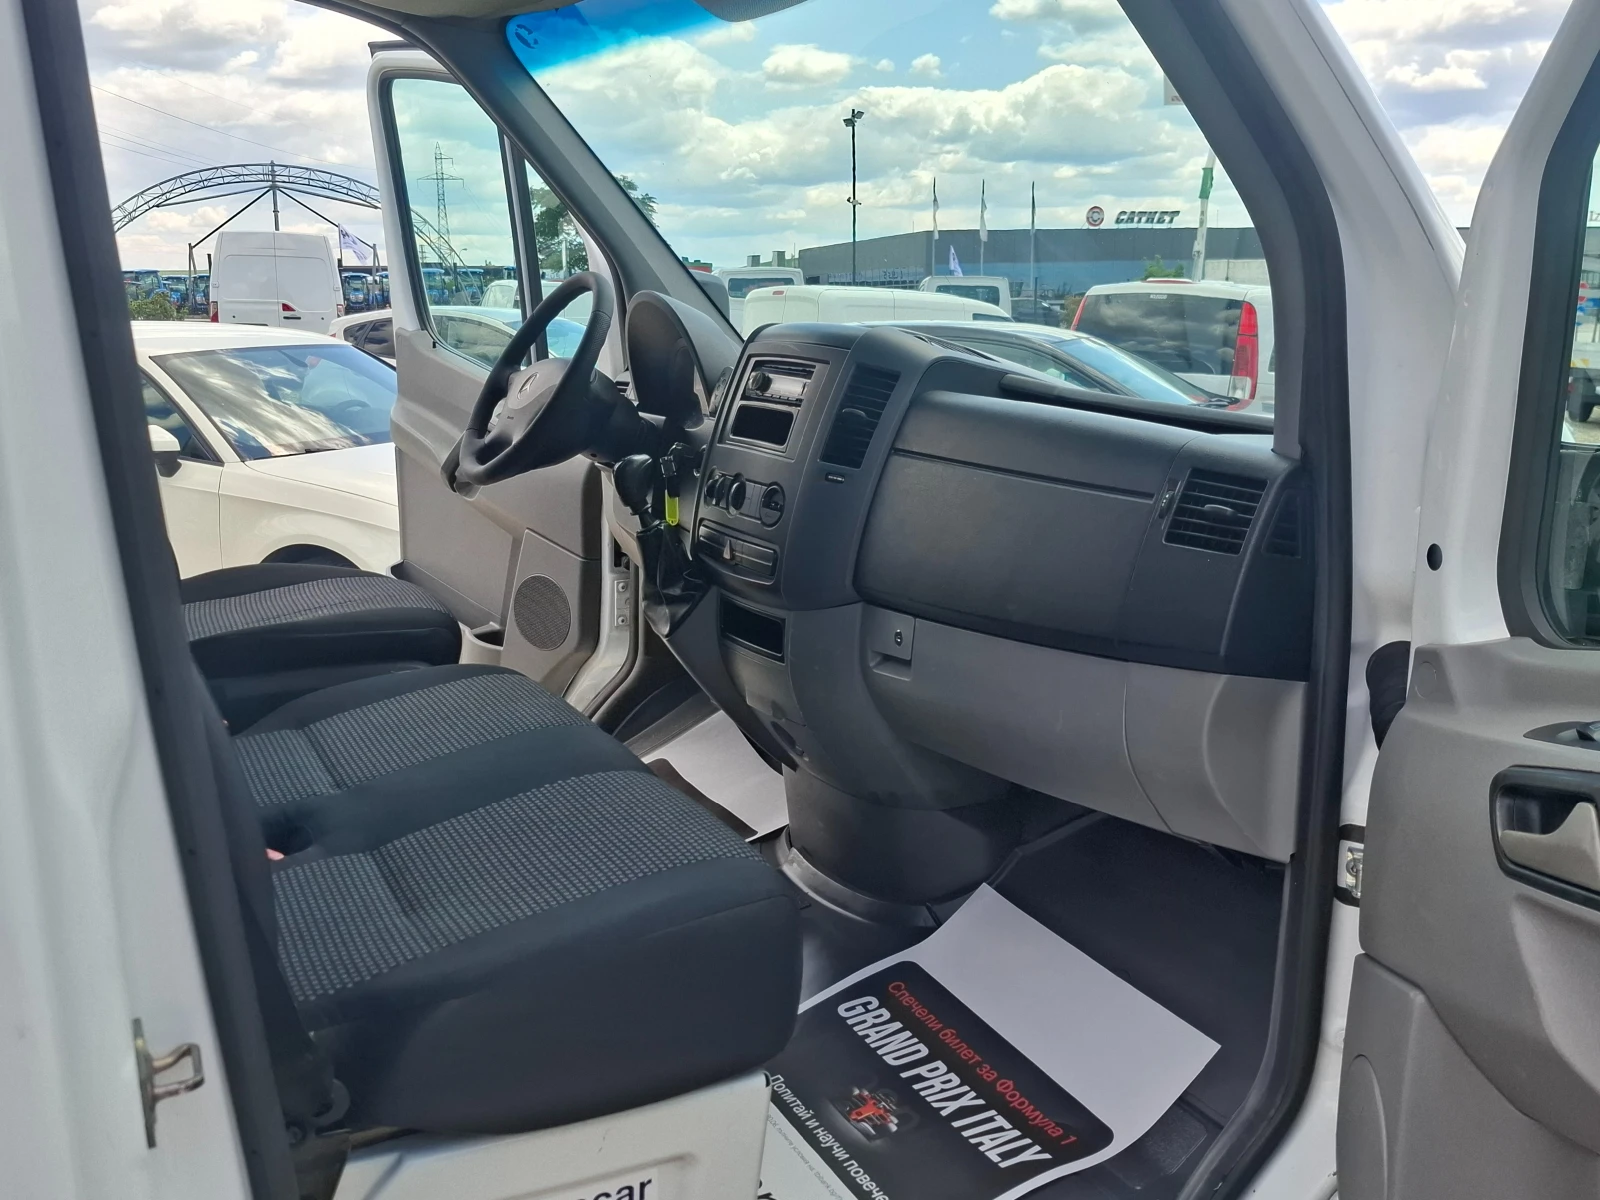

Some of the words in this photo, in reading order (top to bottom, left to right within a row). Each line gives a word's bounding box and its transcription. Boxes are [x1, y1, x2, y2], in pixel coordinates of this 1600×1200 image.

[770, 1074, 815, 1121] Попитай
[805, 1118, 820, 1129] и
[813, 1127, 850, 1161] научи
[837, 996, 929, 1066] GRAND
[900, 1060, 985, 1117] PRIX
[951, 1109, 1053, 1169] ITALY
[888, 981, 943, 1031] Спечели
[938, 1029, 982, 1065] билет
[976, 1063, 998, 1081] за
[996, 1079, 1064, 1137] Формула
[1060, 1135, 1077, 1145] 1
